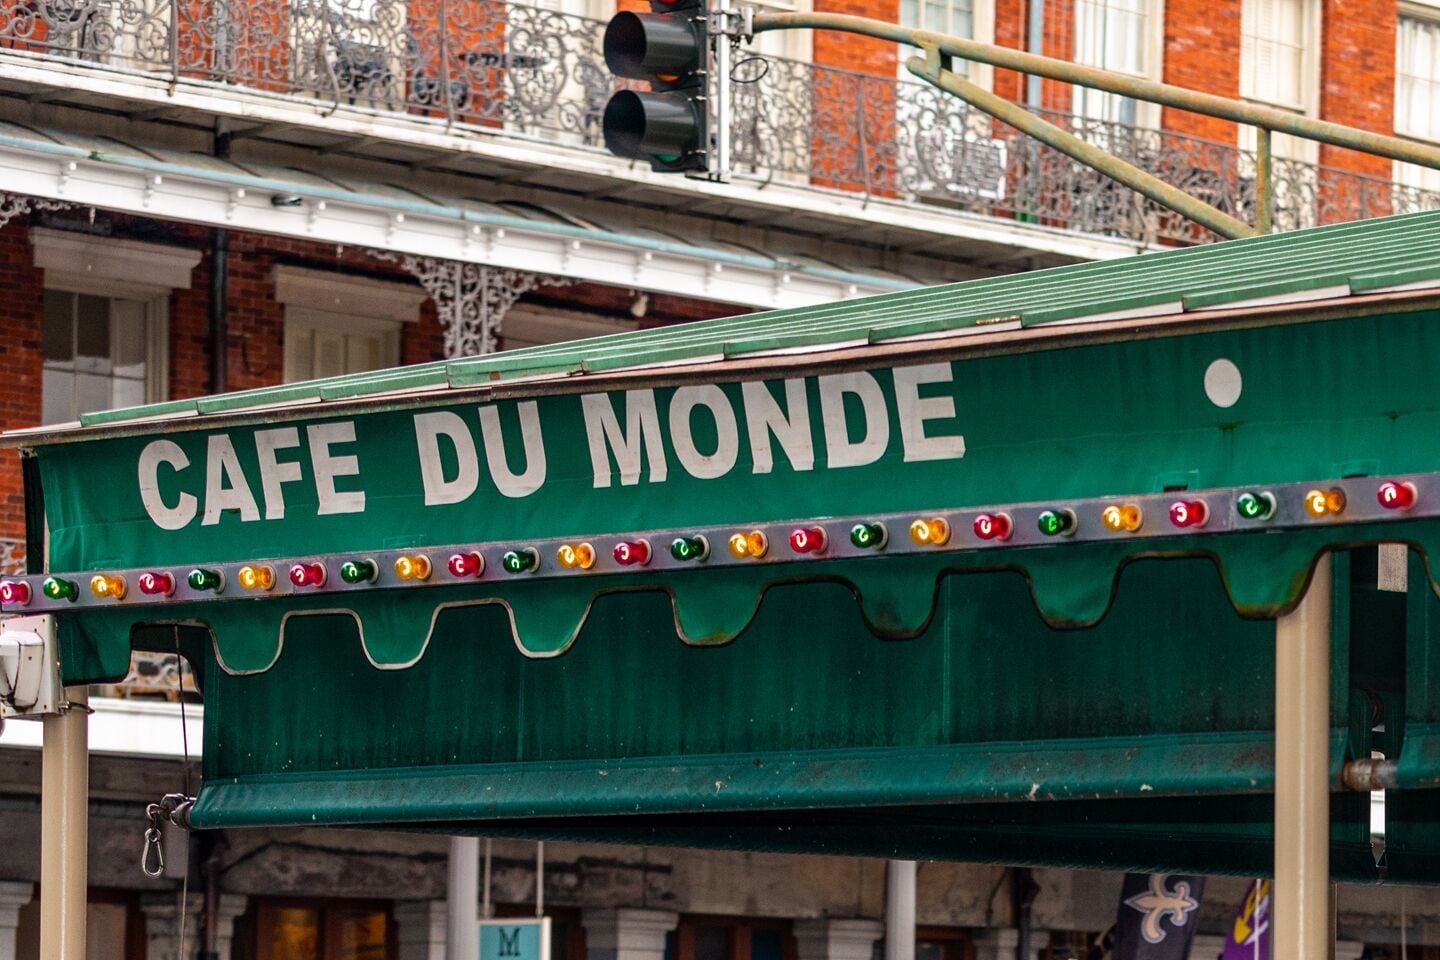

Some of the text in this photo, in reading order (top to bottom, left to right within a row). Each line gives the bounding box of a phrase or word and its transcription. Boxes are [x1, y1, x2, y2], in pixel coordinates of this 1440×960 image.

[138, 421, 366, 531] CAFE
[414, 400, 547, 506] DU
[582, 361, 966, 489] MONDE
[499, 927, 520, 956] M
